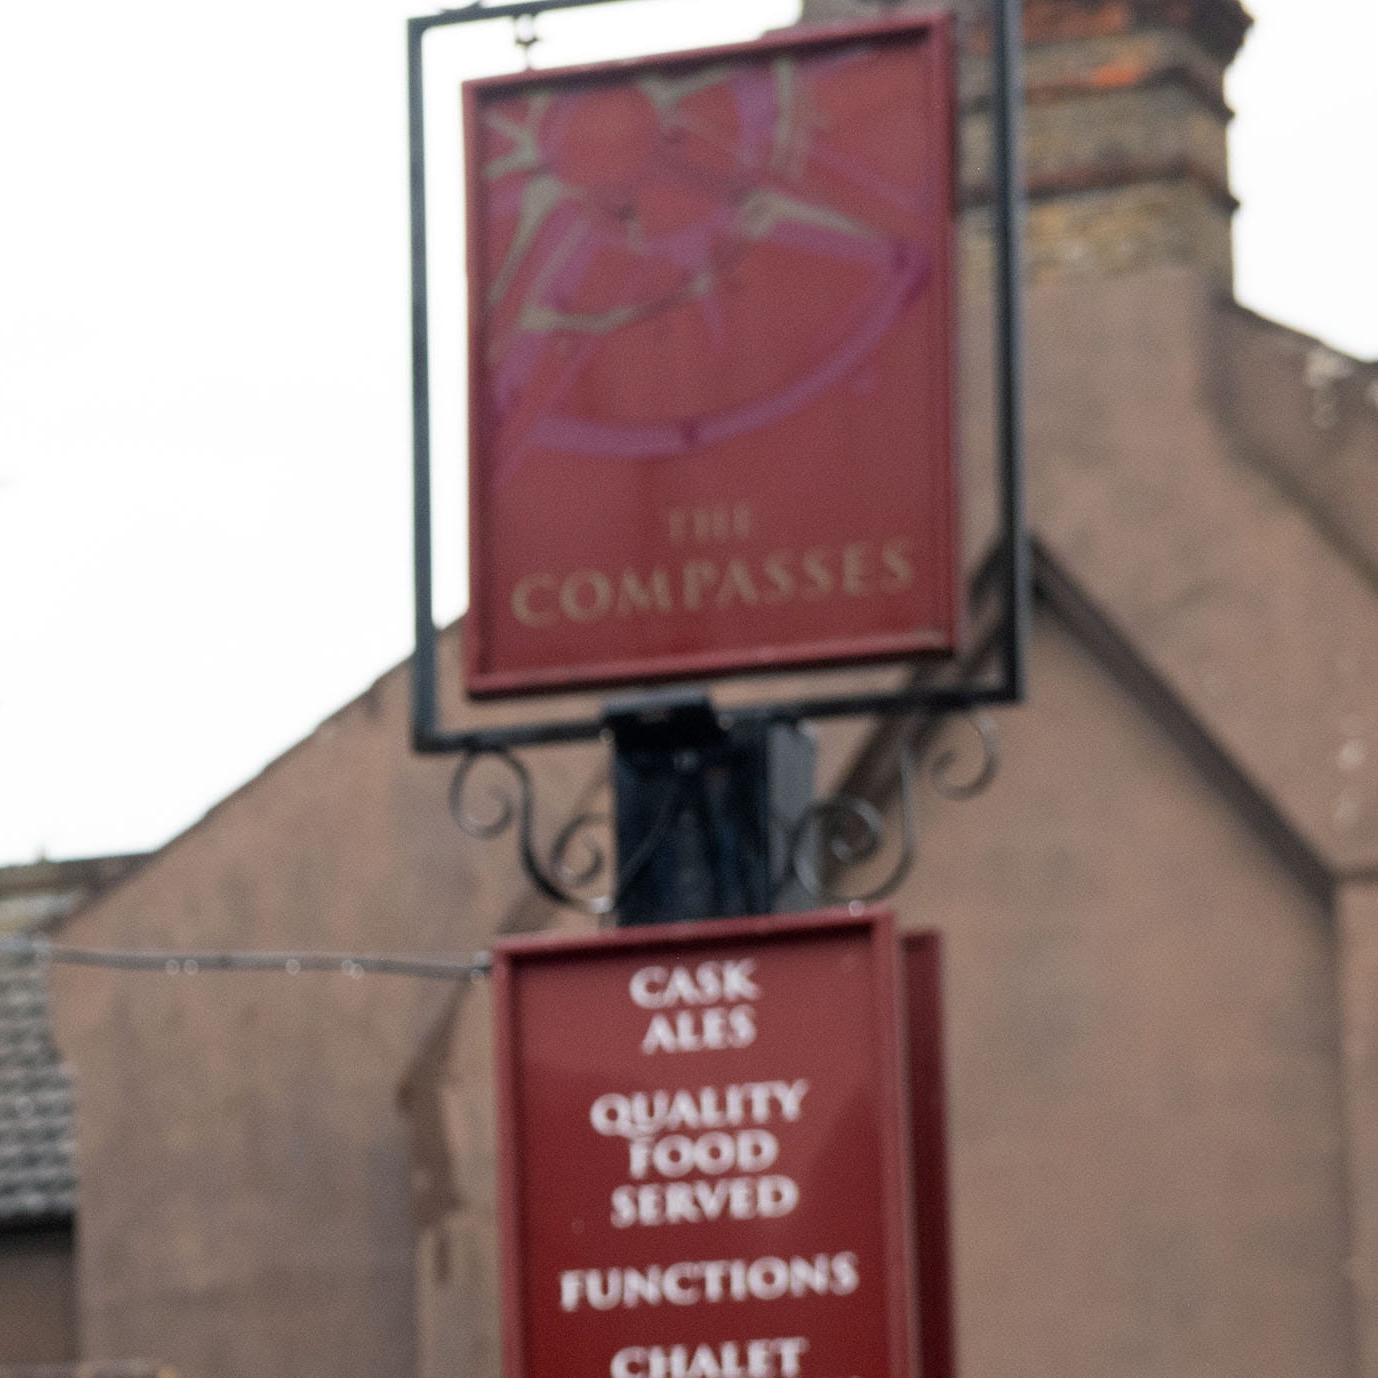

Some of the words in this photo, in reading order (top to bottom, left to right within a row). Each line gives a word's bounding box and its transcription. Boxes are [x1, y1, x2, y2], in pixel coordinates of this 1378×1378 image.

[511, 540, 913, 626] COMPASSES
[630, 961, 758, 1007] CASK
[642, 1007, 755, 1054] ALES
[590, 1079, 809, 1138] QUALITY
[630, 1131, 777, 1178] FOOD
[610, 1175, 799, 1229] SERVED
[559, 1251, 858, 1313] FUNCTIONS
